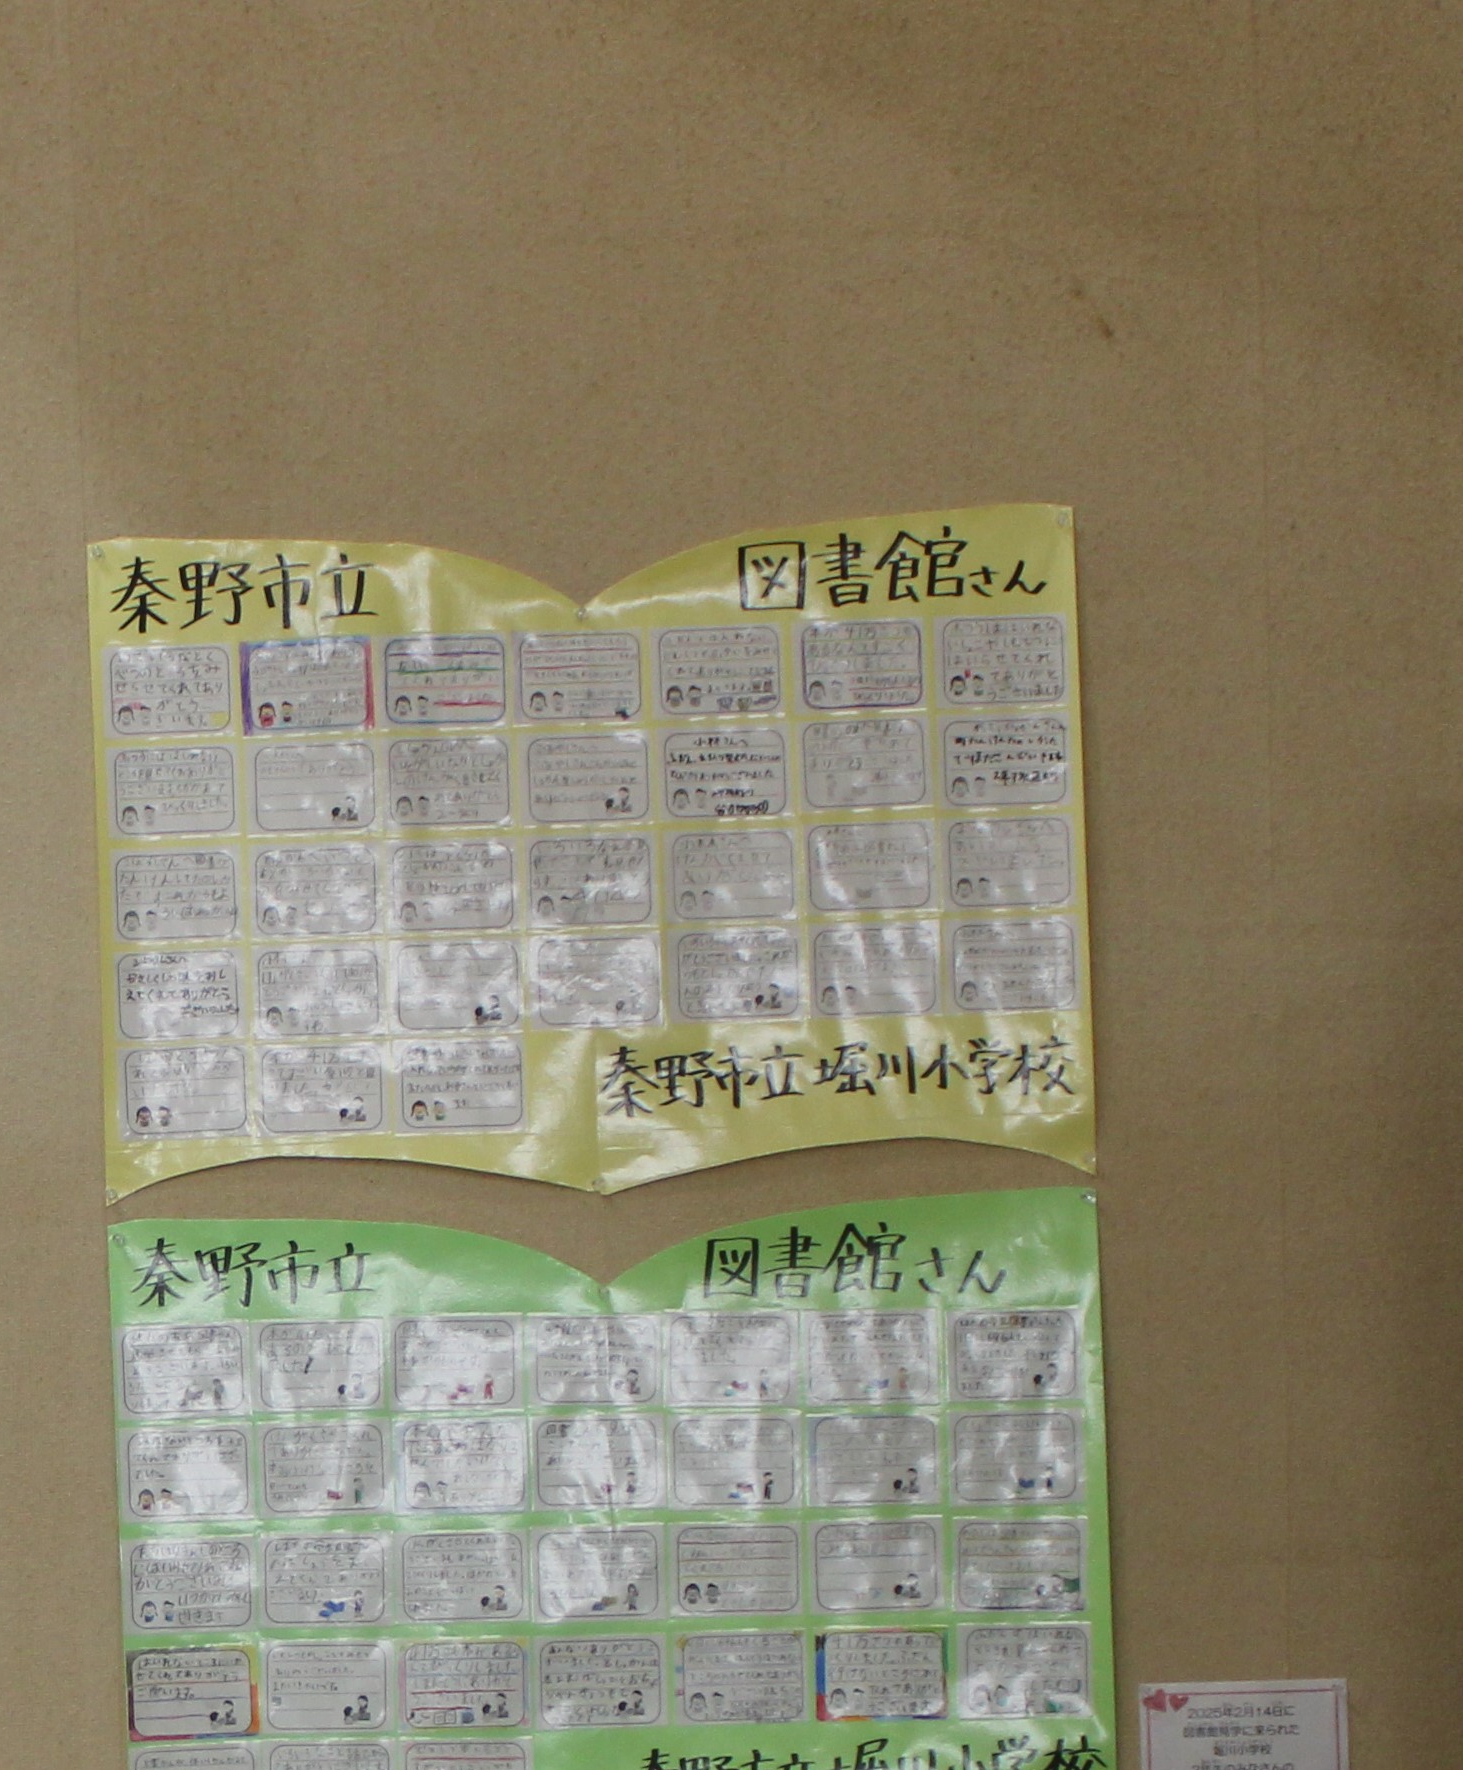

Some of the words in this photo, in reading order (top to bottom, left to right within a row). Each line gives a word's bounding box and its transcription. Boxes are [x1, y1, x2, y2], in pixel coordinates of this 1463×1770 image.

[110, 552, 378, 634] 秦野市立
[738, 525, 1049, 611] 図書館さん
[601, 1035, 1076, 1118] 秦野市立堀川小学校
[130, 1238, 375, 1308] 秦野市立
[703, 1222, 1009, 1299] 図書館さん
